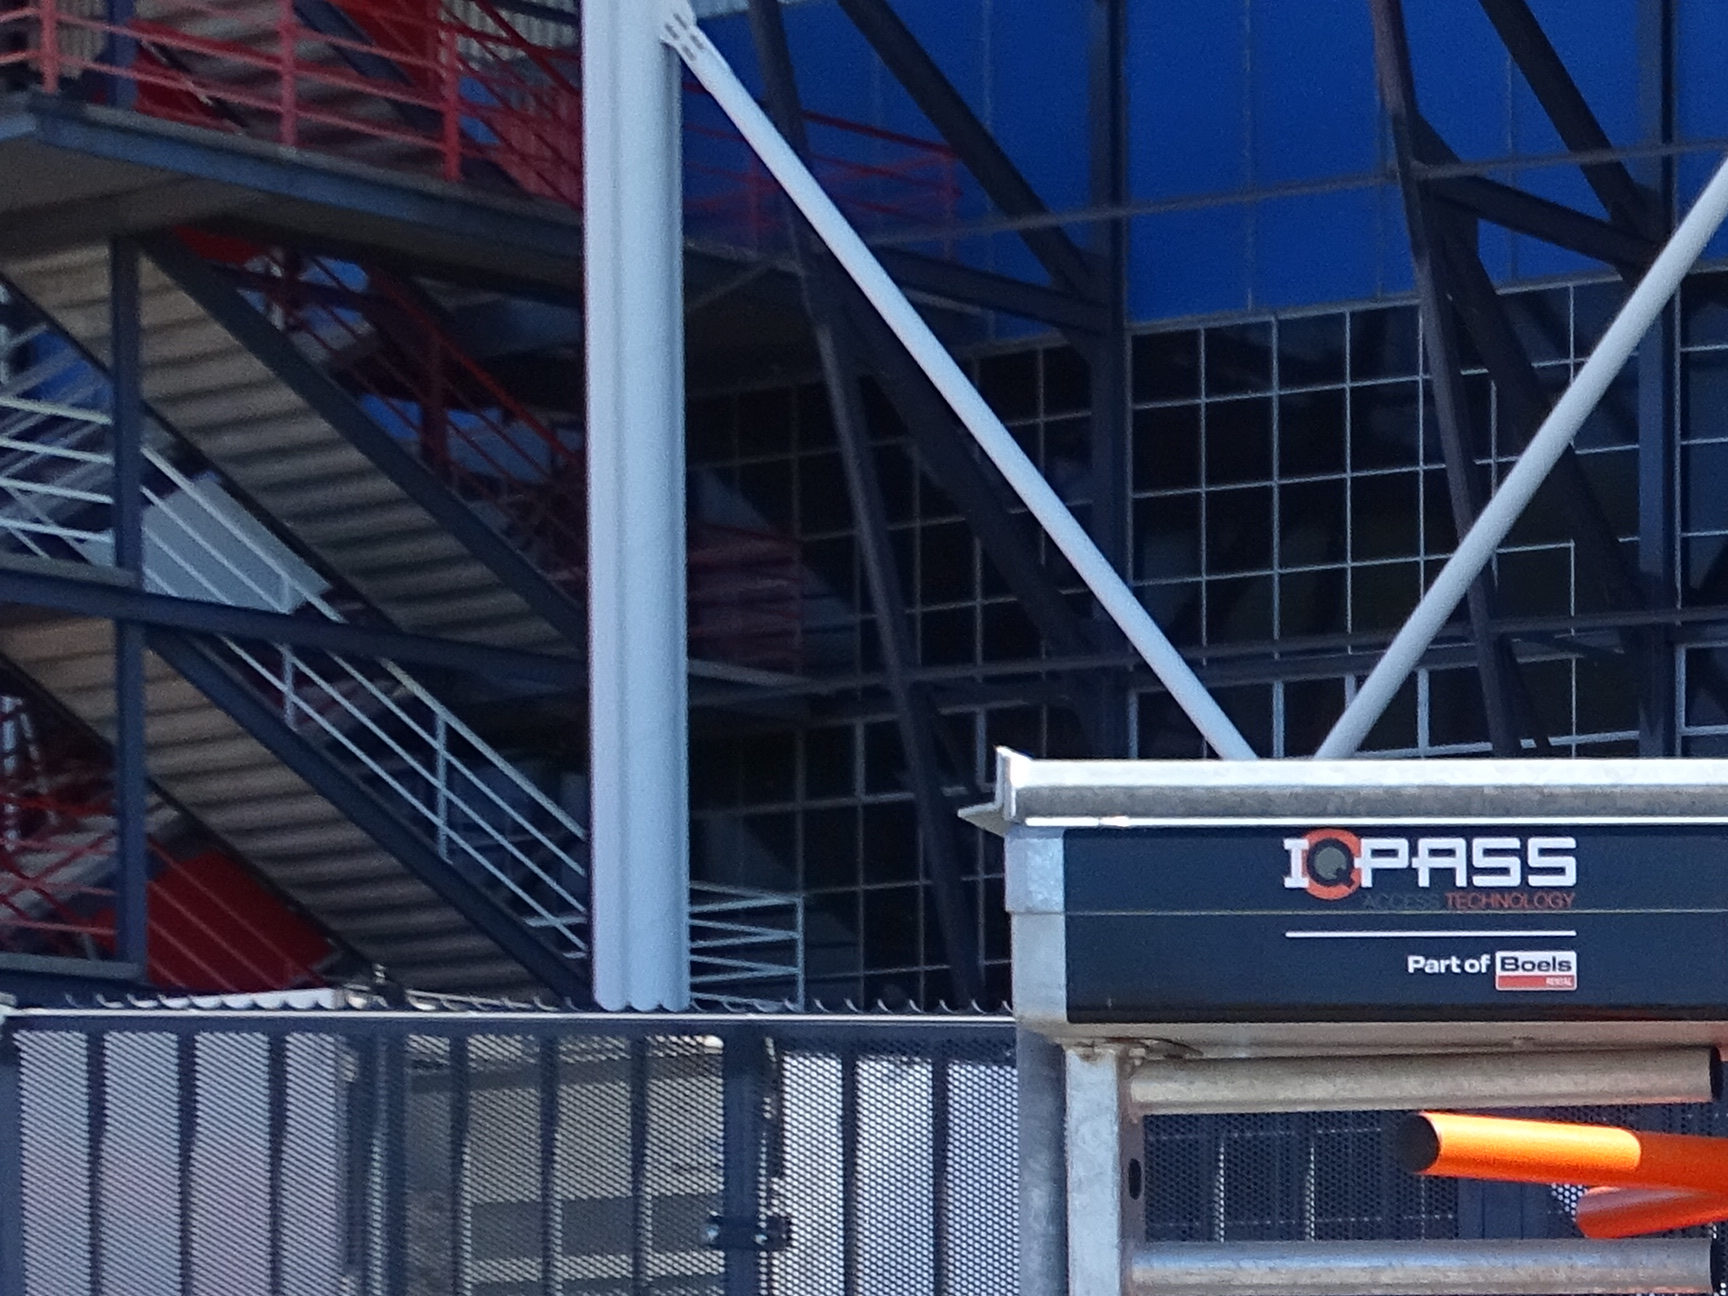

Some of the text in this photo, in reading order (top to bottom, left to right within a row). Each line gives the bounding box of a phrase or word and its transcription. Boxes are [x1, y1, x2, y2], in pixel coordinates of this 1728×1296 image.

[1445, 892, 1576, 910] TECHNOLOGY
[1407, 954, 1572, 975] Part of Boels
